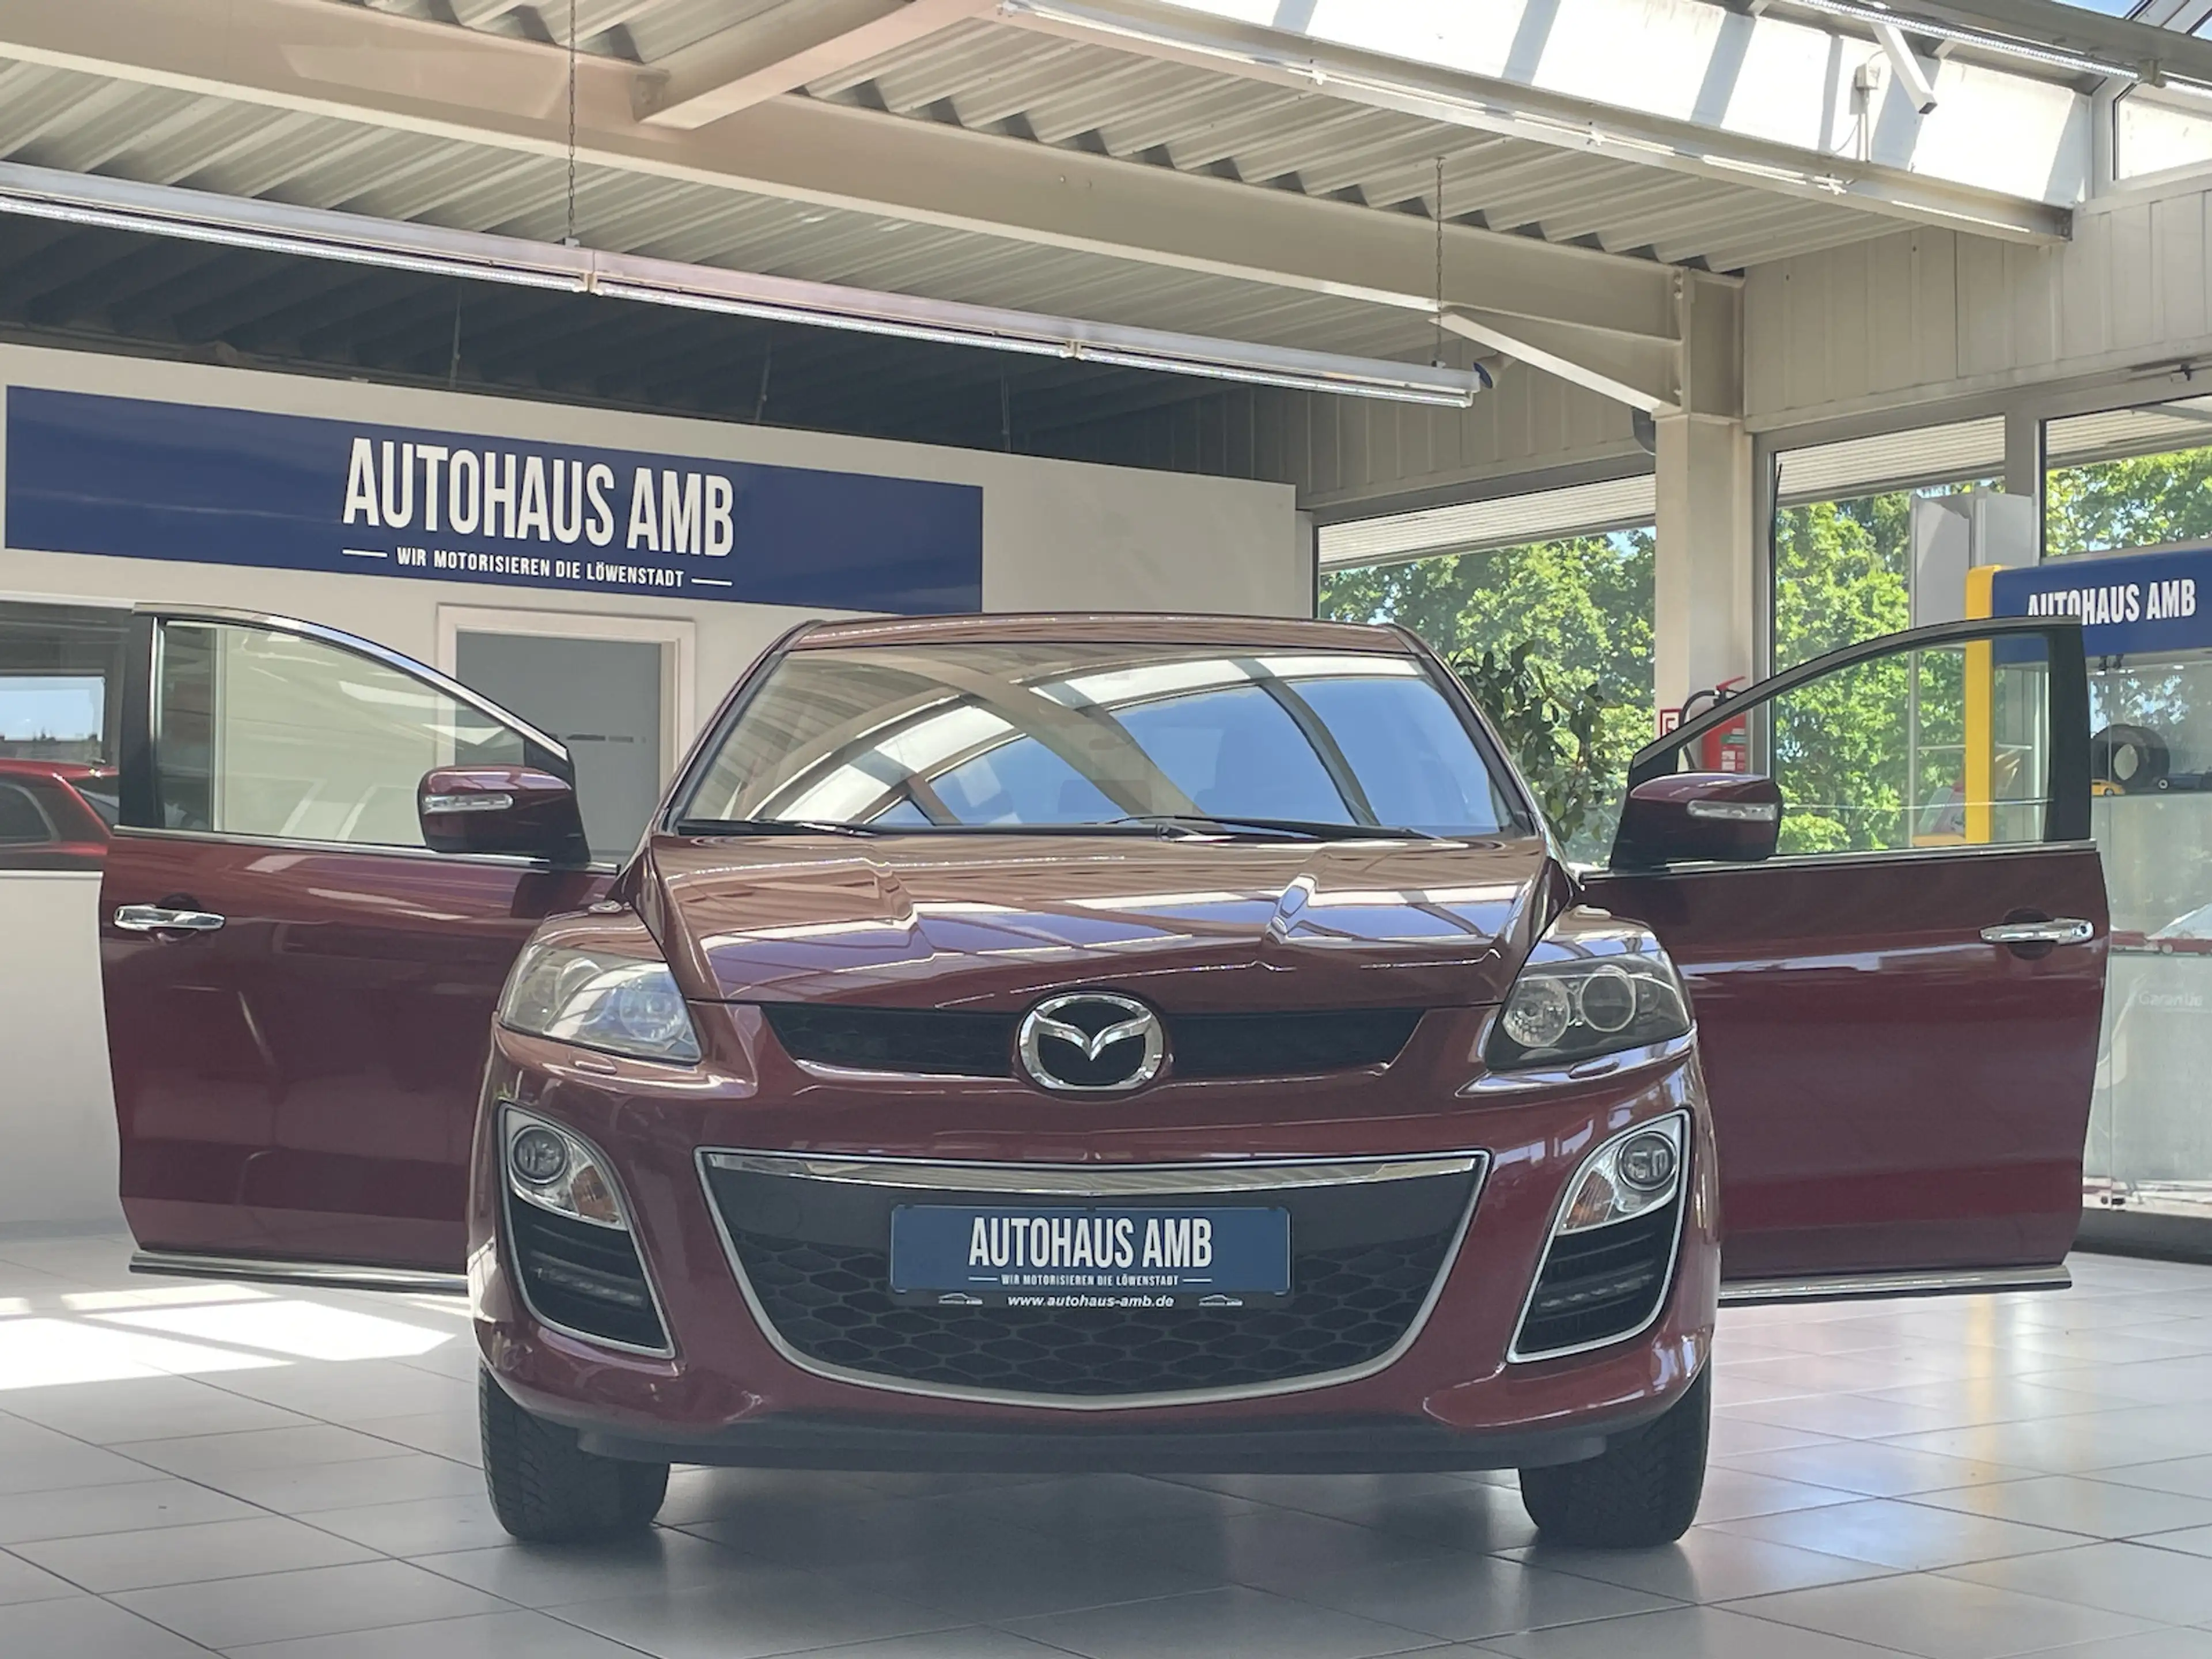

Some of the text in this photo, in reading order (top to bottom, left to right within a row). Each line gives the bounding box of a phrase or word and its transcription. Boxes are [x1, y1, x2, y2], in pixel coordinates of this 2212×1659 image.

[343, 437, 734, 557] AUTOHAUS AMB
[396, 547, 684, 588] WIR MOTORISIEREN DIE LÖWENSTADT
[2146, 578, 2196, 620] AMB
[969, 1216, 1213, 1268] AUTOHAUS AMB
[1001, 1274, 1179, 1286] WIR MOTORISIEREN DIE LÖWENSTADT
[1007, 1295, 1175, 1308] www.autohaus-amb.de
